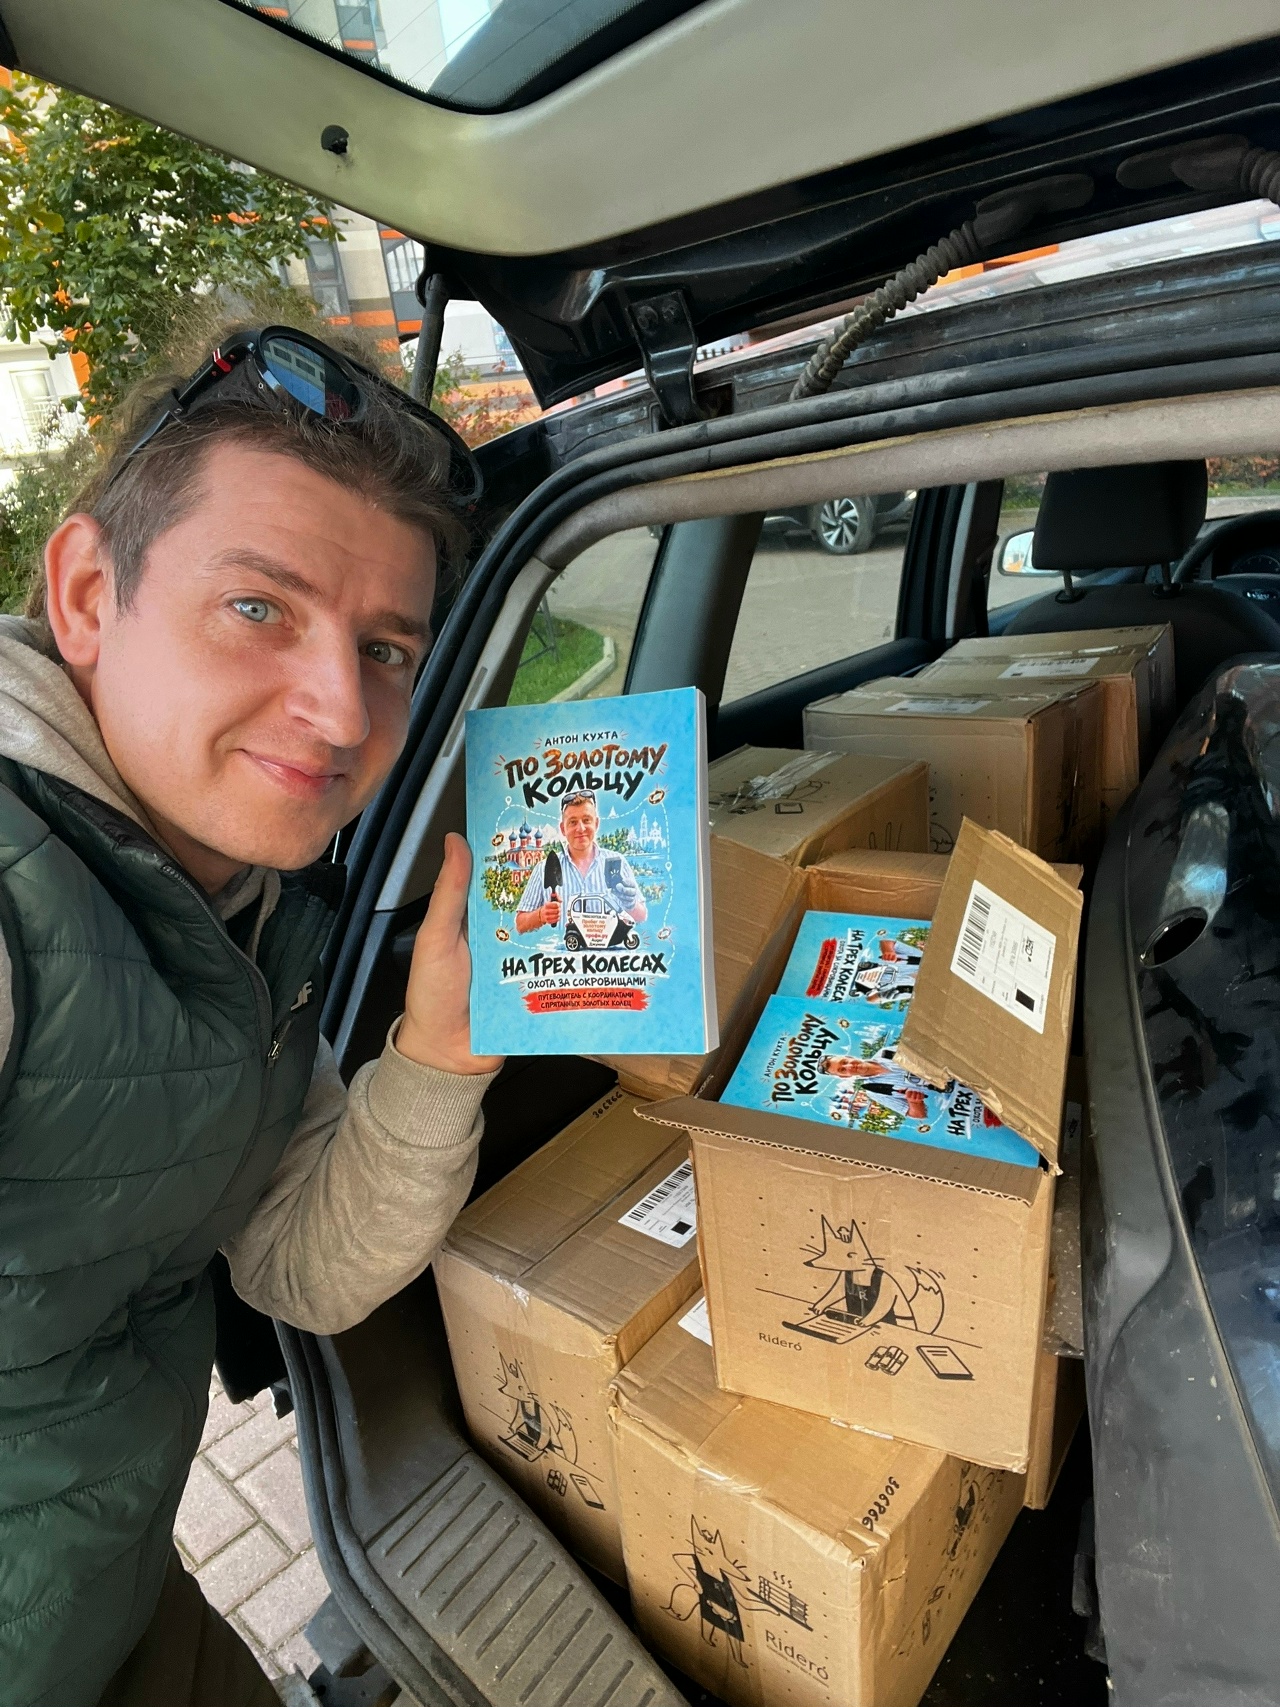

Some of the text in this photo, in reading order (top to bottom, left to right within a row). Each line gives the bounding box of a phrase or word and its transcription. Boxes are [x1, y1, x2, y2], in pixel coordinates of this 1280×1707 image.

[544, 730, 618, 747] АНТОН КУХТА
[504, 743, 668, 788] ПО ЗОЛОТОМУ
[522, 770, 645, 808] КОЛЬЦУ
[501, 952, 668, 978] НА ТРЕХ КОЛЕСАХ
[527, 976, 647, 989] ОХОТА ЗА СОКРОВИЩАМИ
[829, 967, 854, 1003] КОЛЕСА
[794, 1027, 840, 1095] КОЛЬЦУ
[862, 1476, 900, 1532] 306866
